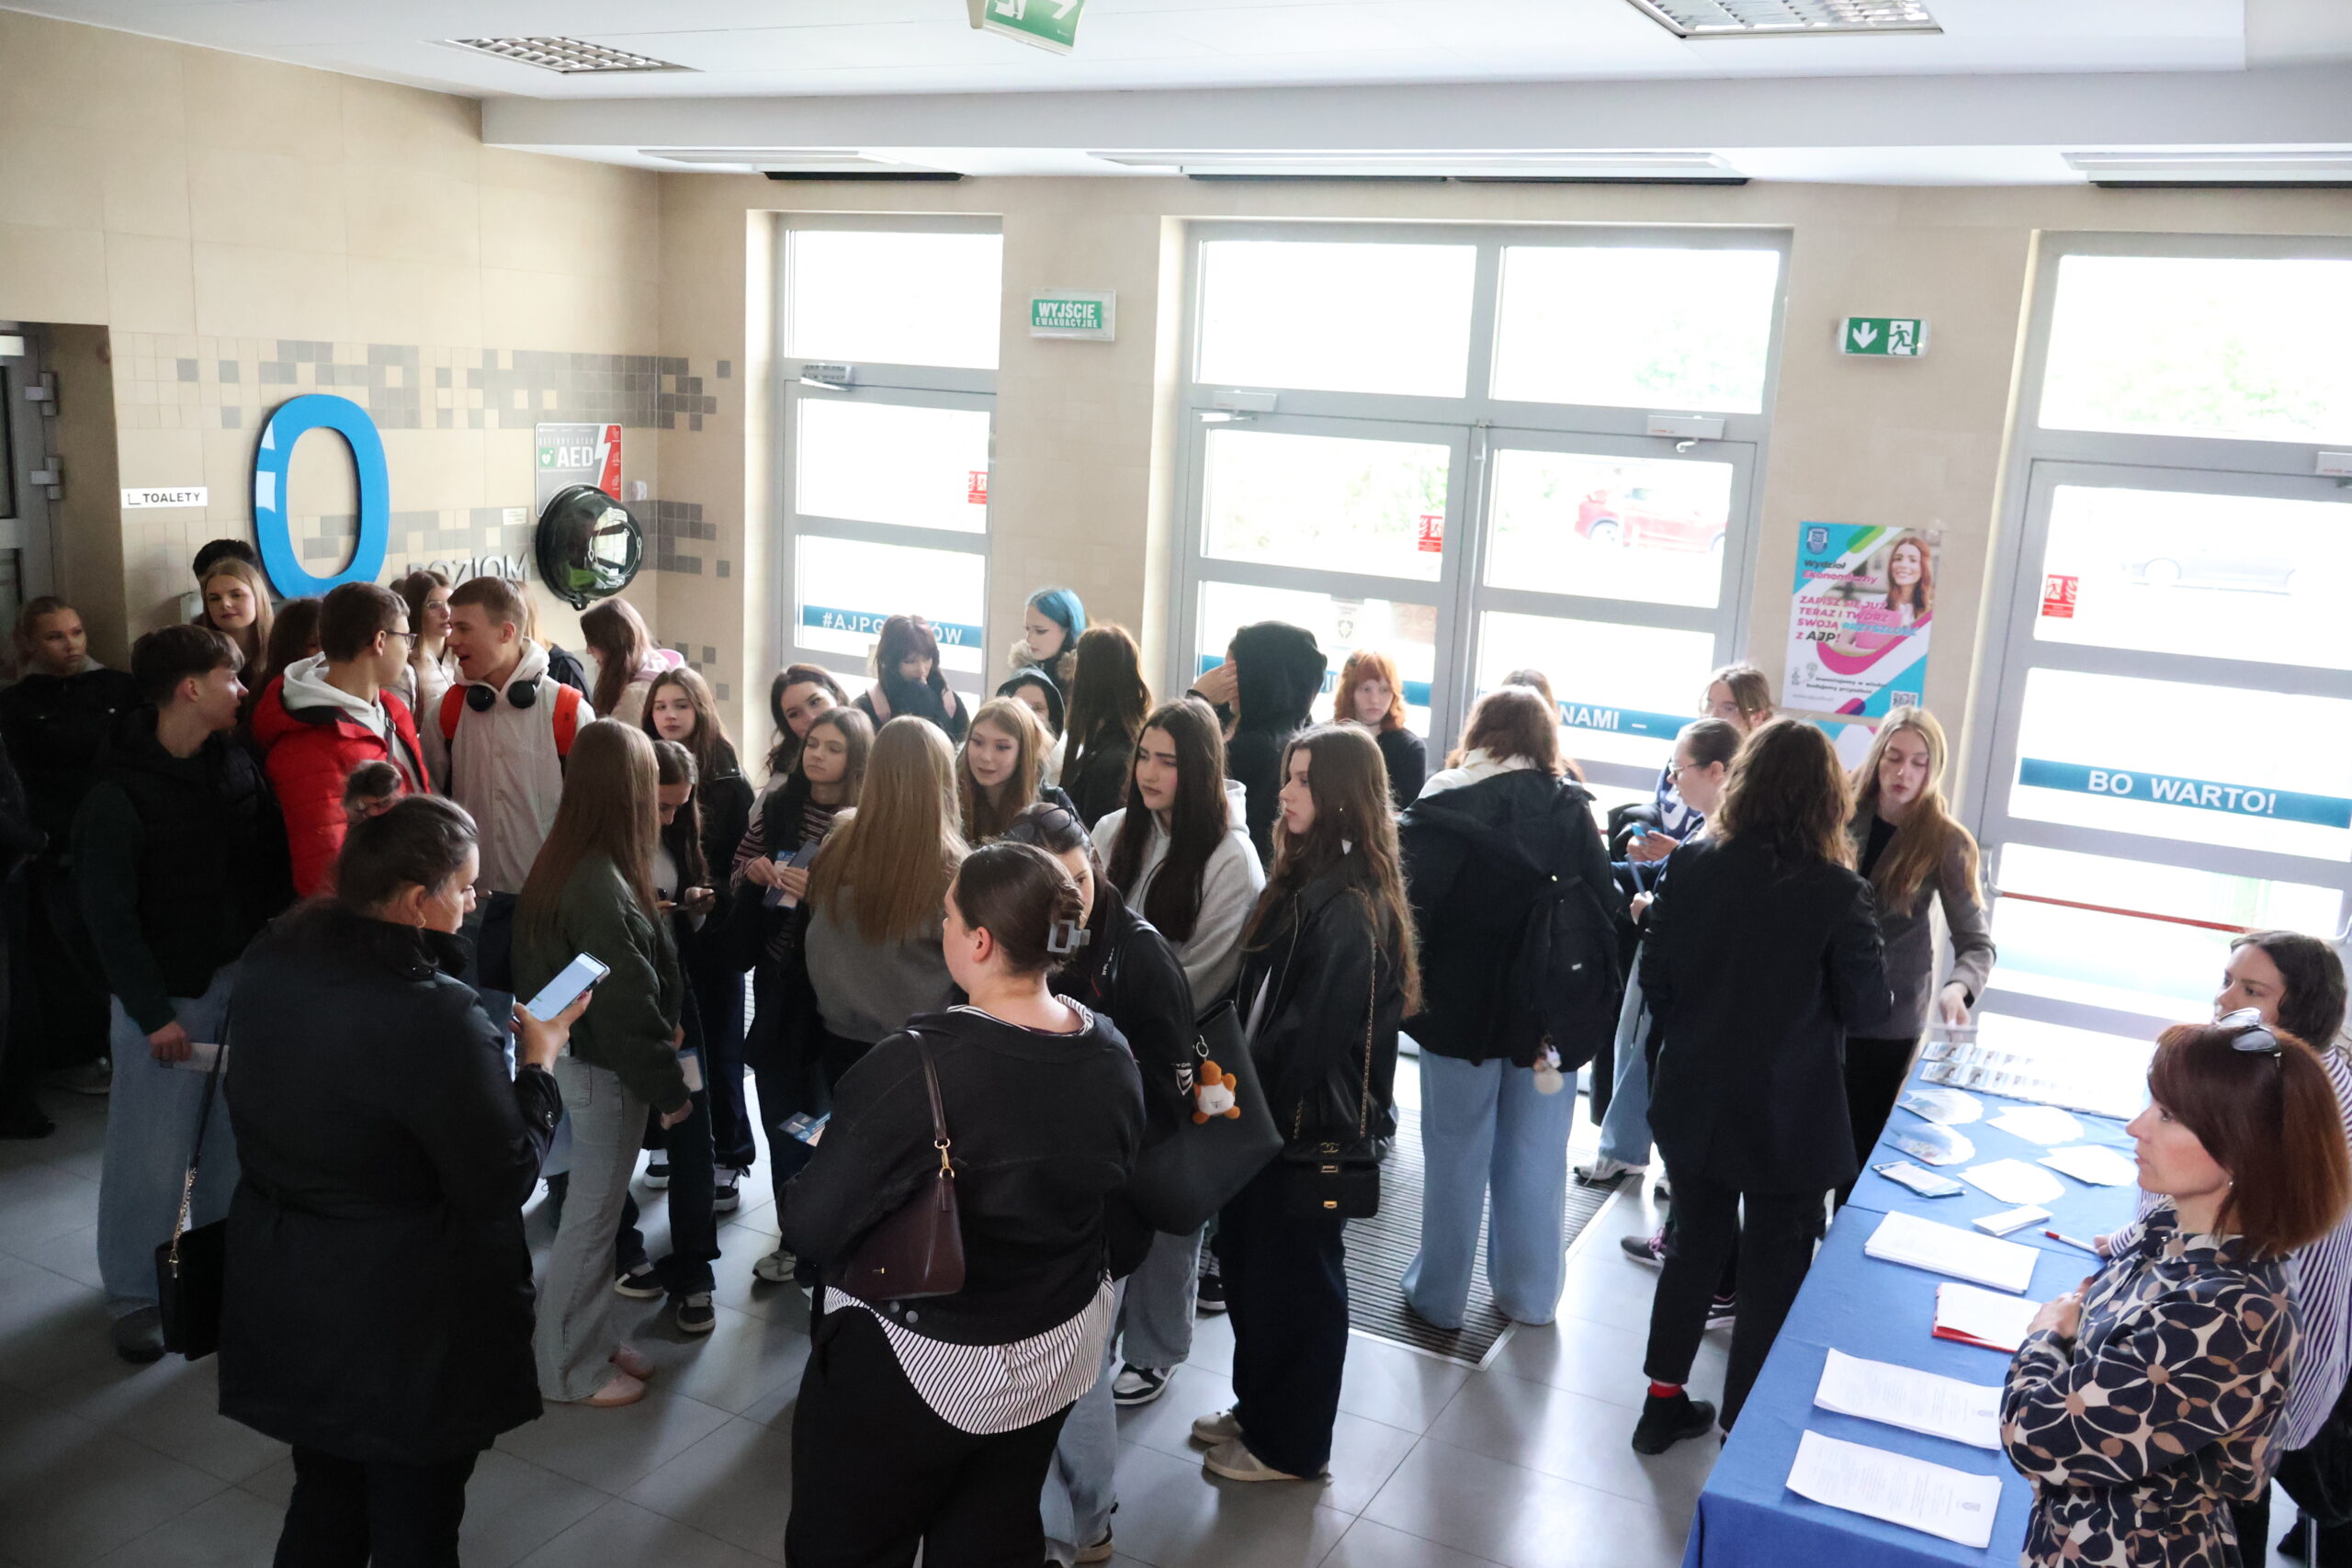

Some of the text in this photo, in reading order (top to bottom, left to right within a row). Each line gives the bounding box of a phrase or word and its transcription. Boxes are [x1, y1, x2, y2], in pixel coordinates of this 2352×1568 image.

[1038, 301, 1095, 319] WYJŚCIE
[557, 446, 594, 468] AED
[142, 492, 200, 503] TOALETY
[1804, 559, 1847, 570] Wydział
[1802, 570, 1878, 584] Ekonomiczny
[1799, 595, 1840, 607] ZAPISZ
[1799, 606, 1836, 617] TERAZ
[822, 612, 963, 644] #AJPGÓW
[1795, 631, 1804, 640] Z
[1559, 705, 1619, 729] NAMI
[2088, 771, 2278, 815] BO WARTO!
